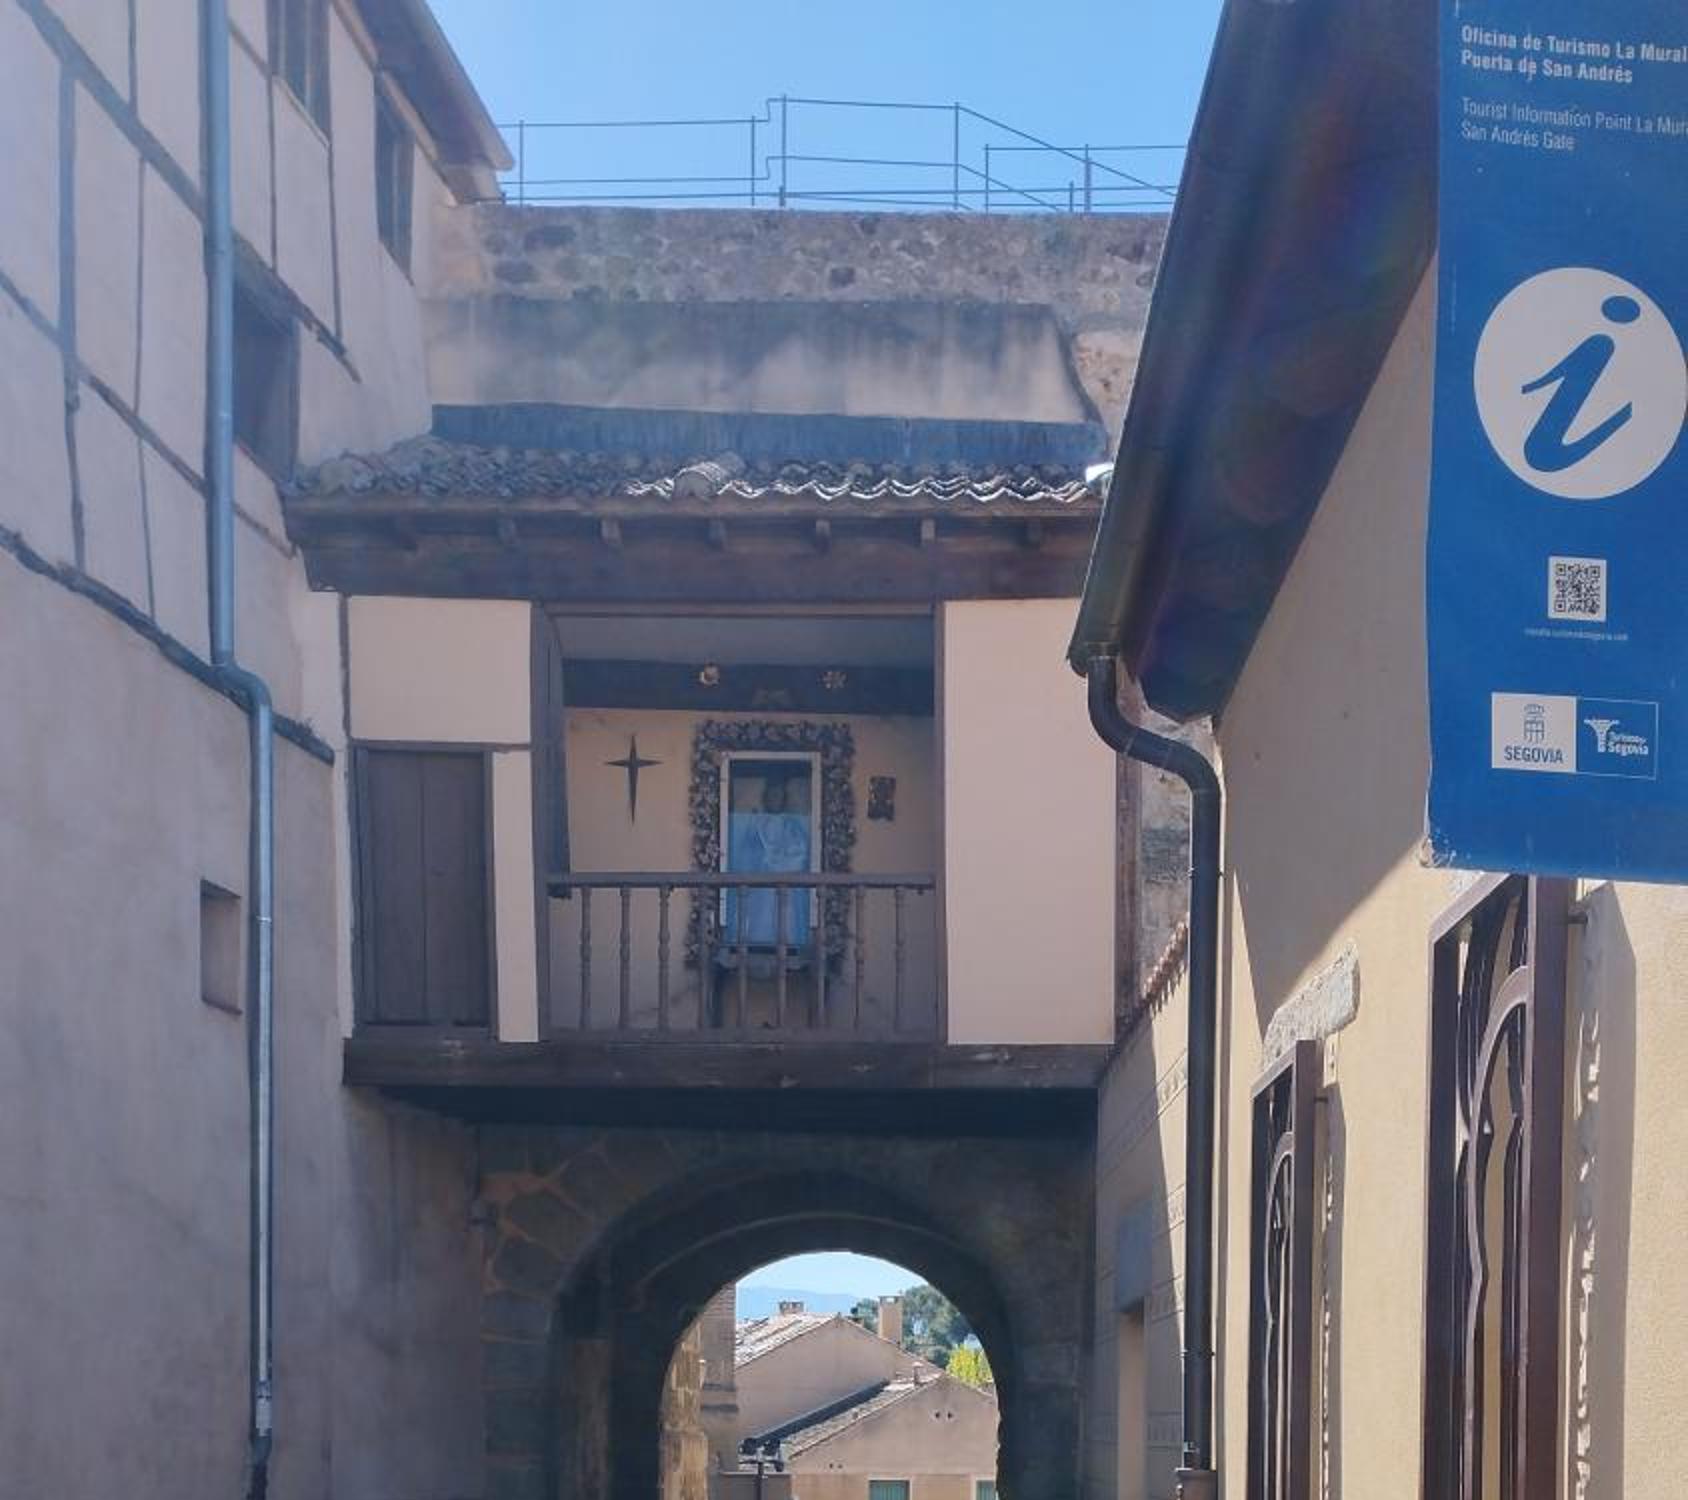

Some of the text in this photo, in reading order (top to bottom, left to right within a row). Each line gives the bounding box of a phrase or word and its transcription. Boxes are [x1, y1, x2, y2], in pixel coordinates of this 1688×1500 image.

[1461, 24, 1517, 49] Oficina
[1523, 33, 1542, 51] de
[1547, 35, 1610, 59] Turismo
[1616, 40, 1635, 60] La
[1461, 48, 1633, 84] Puerta de San Andrés
[1462, 97, 1507, 119] Tourist
[1595, 112, 1632, 129] Point
[1637, 116, 1653, 133] La
[1461, 120, 1487, 140] San
[1543, 132, 1575, 151] Gate
[1504, 745, 1564, 764] SEGOVIA
